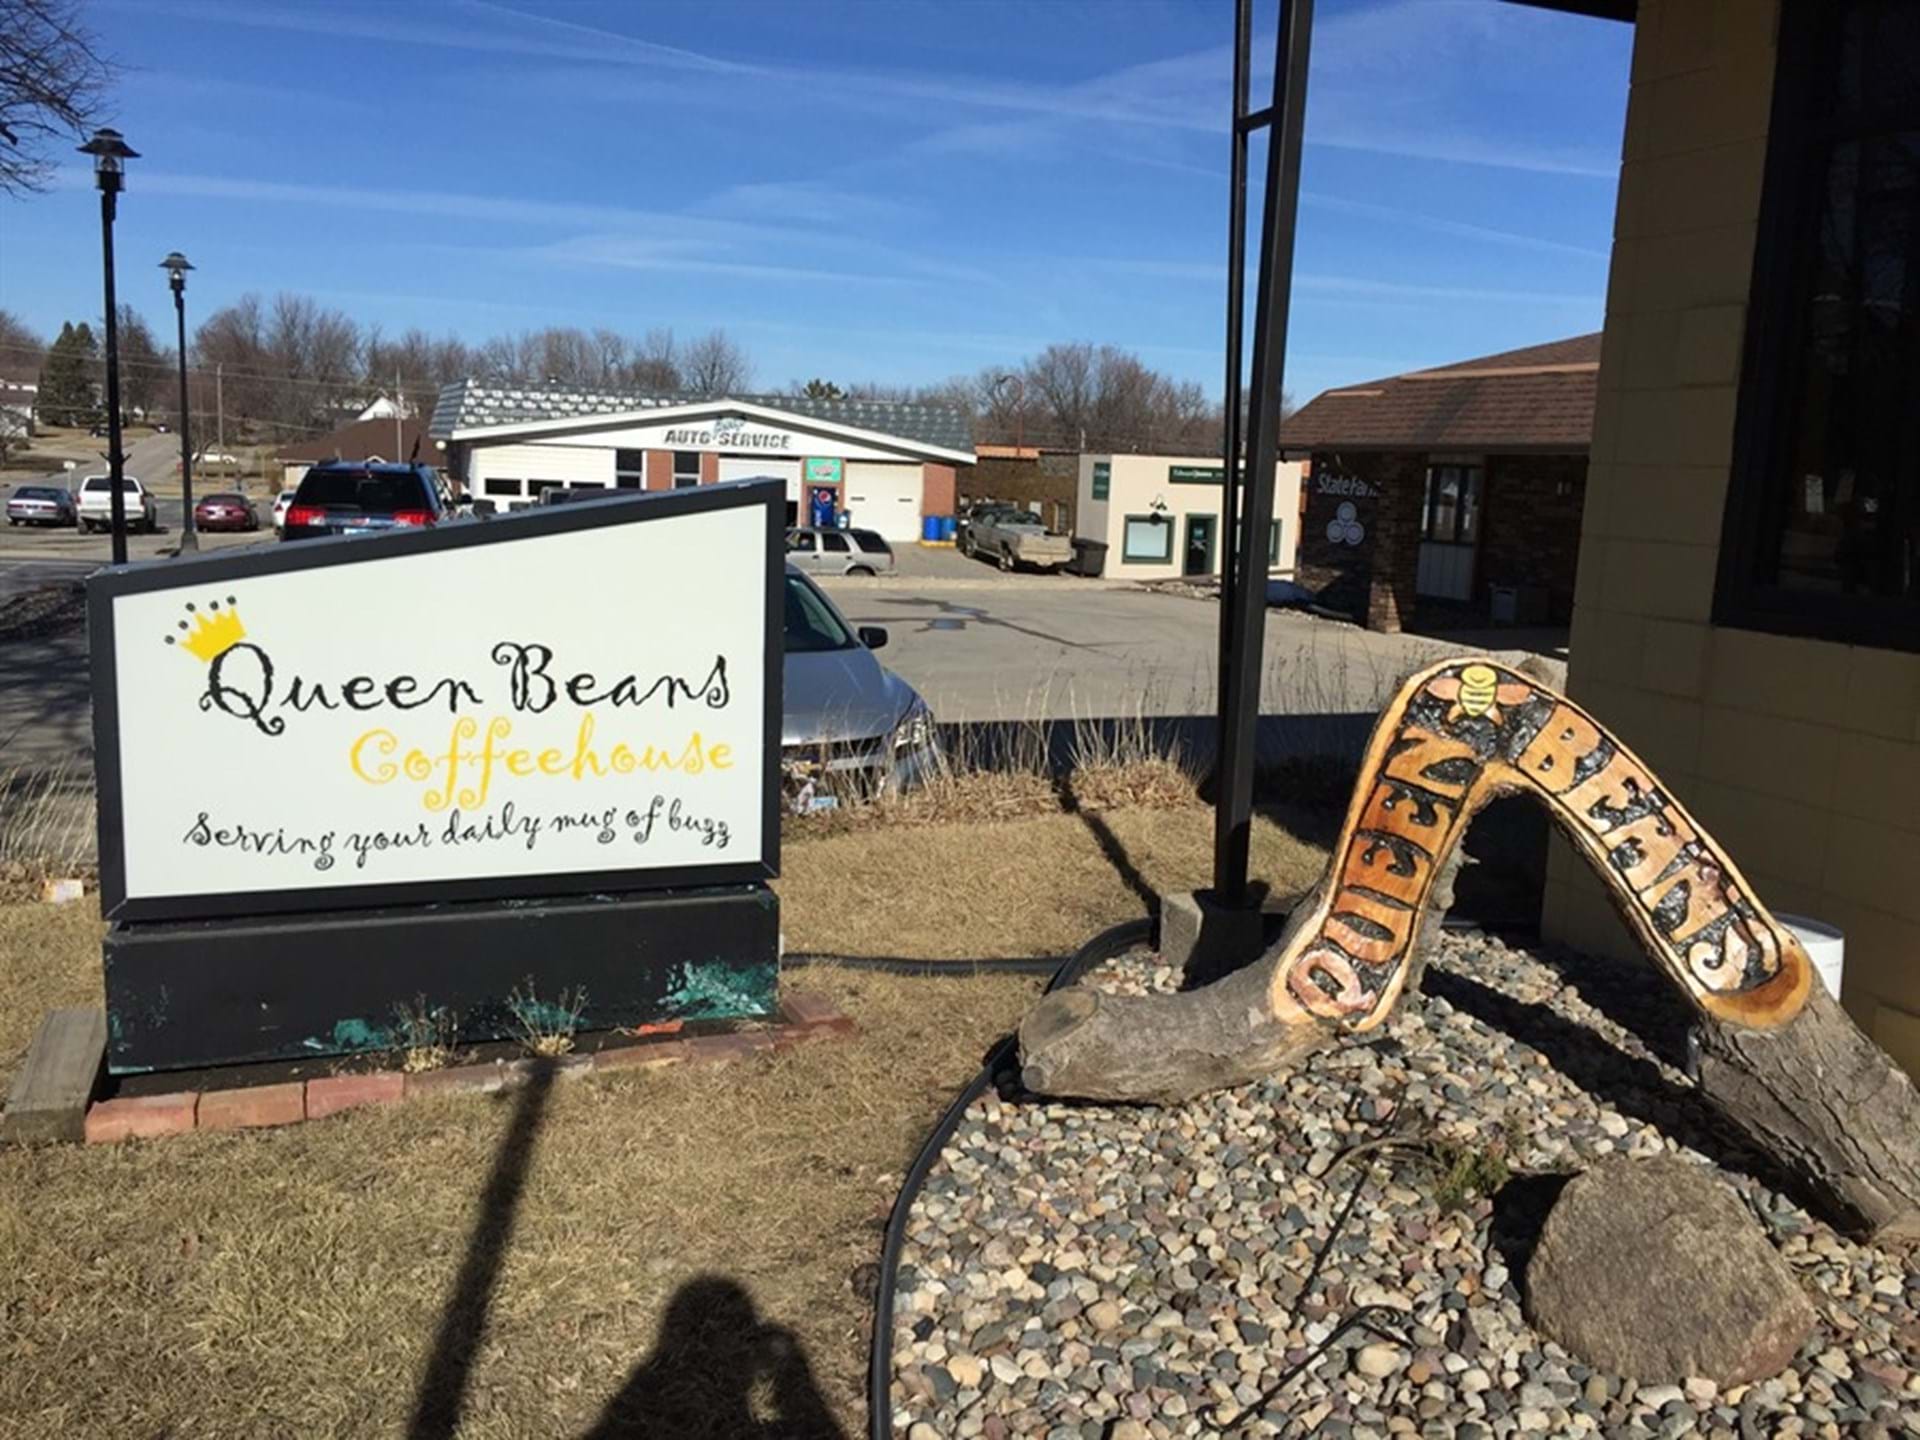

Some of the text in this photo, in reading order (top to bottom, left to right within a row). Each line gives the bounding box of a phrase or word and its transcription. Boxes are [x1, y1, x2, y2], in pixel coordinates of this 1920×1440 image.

[664, 429, 791, 449] AUTO SERVICE
[1317, 473, 1350, 496] State
[199, 641, 731, 736] Queen Beans
[349, 712, 733, 811] Coffeehouse
[184, 812, 335, 871] Serving
[344, 823, 433, 871] your
[441, 802, 545, 850] daily
[549, 807, 617, 844] mug
[626, 795, 664, 844] of
[1286, 725, 1486, 1018] QUEEN
[1518, 704, 1781, 991] BEANS
